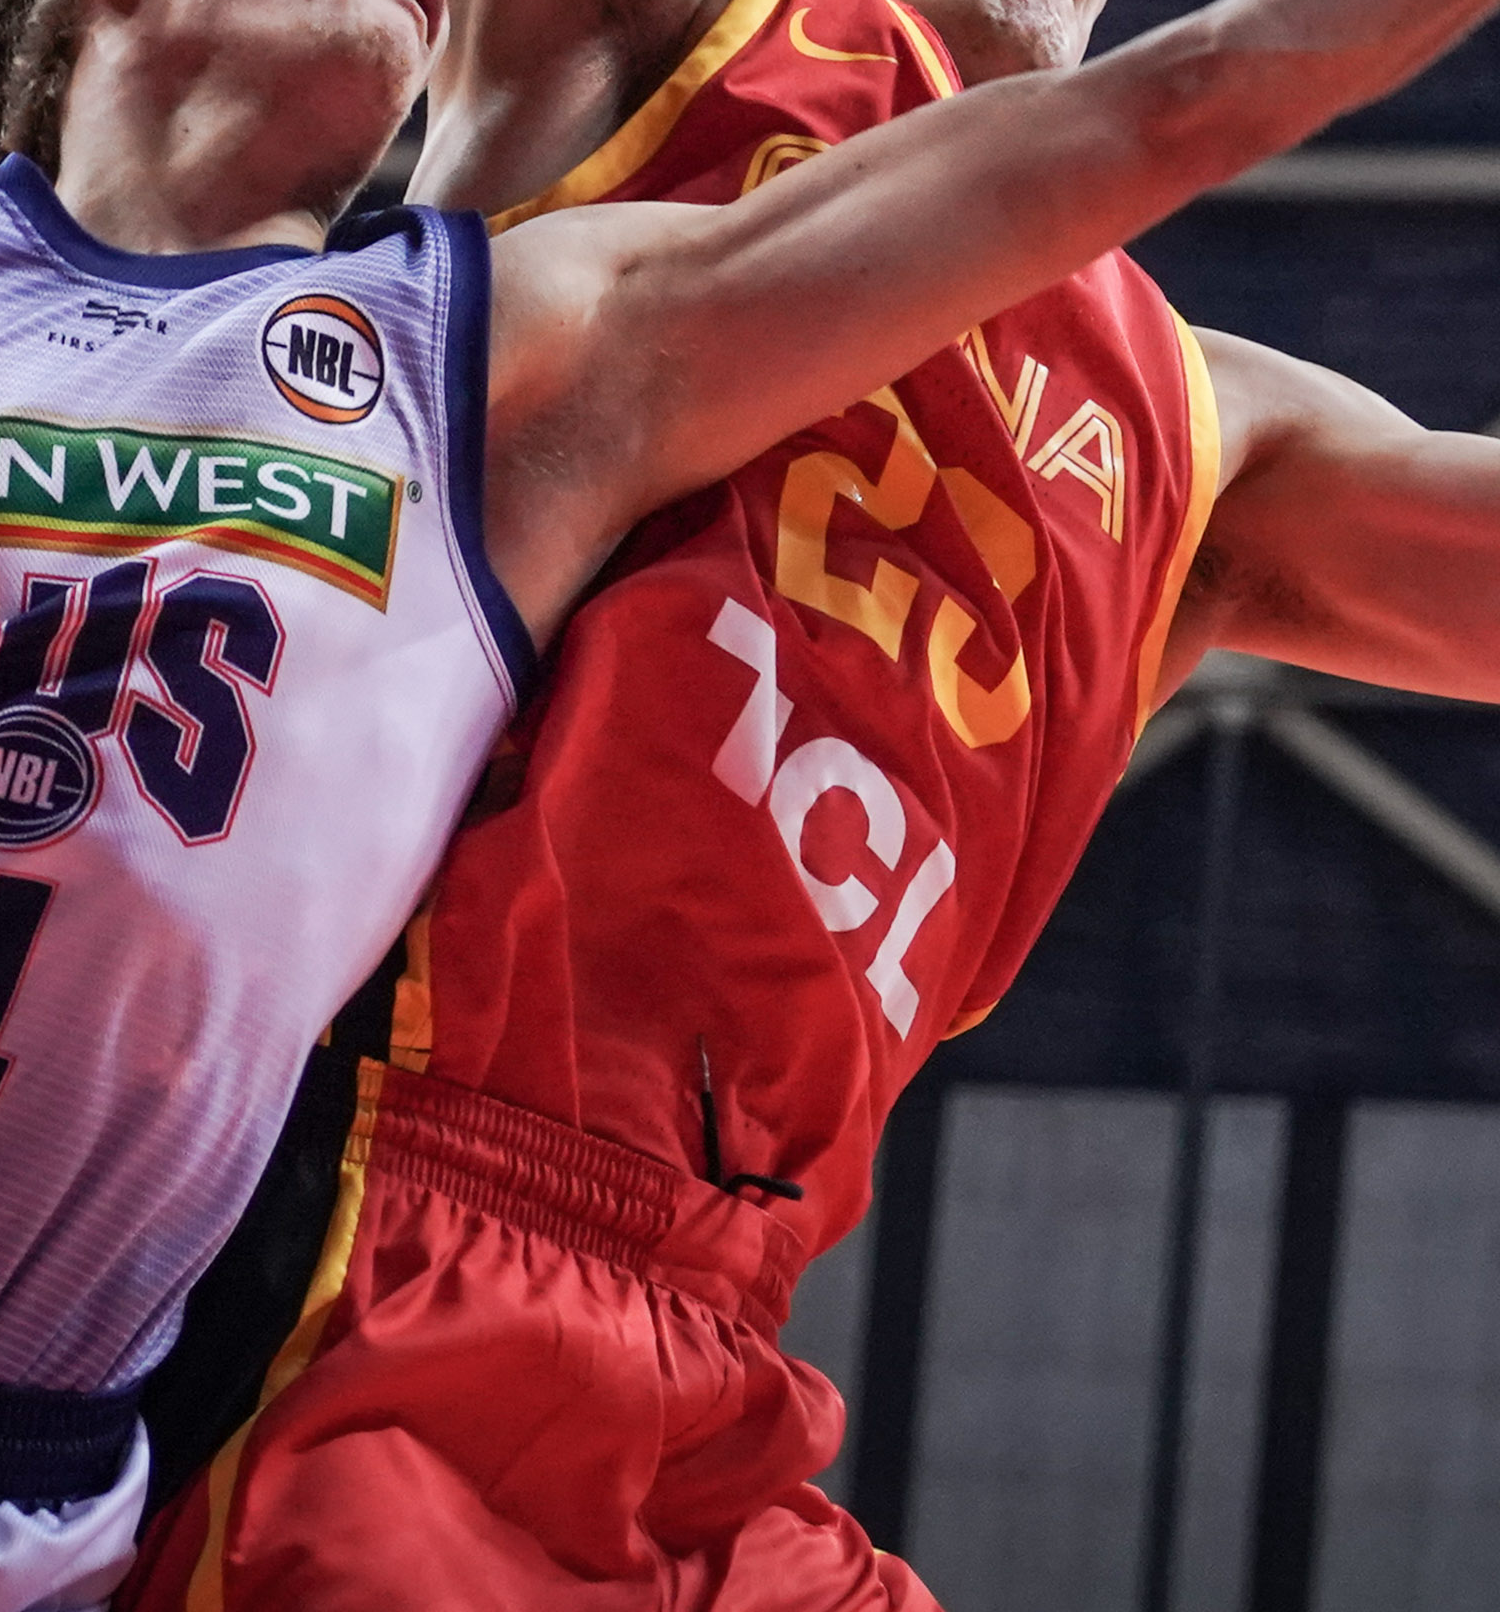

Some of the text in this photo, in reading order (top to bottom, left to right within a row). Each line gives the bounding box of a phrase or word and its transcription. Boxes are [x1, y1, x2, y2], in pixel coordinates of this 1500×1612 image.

[47, 331, 99, 353] FIRS
[288, 323, 355, 397] NBL
[99, 438, 368, 540] WEST
[706, 596, 956, 1042] TCL
